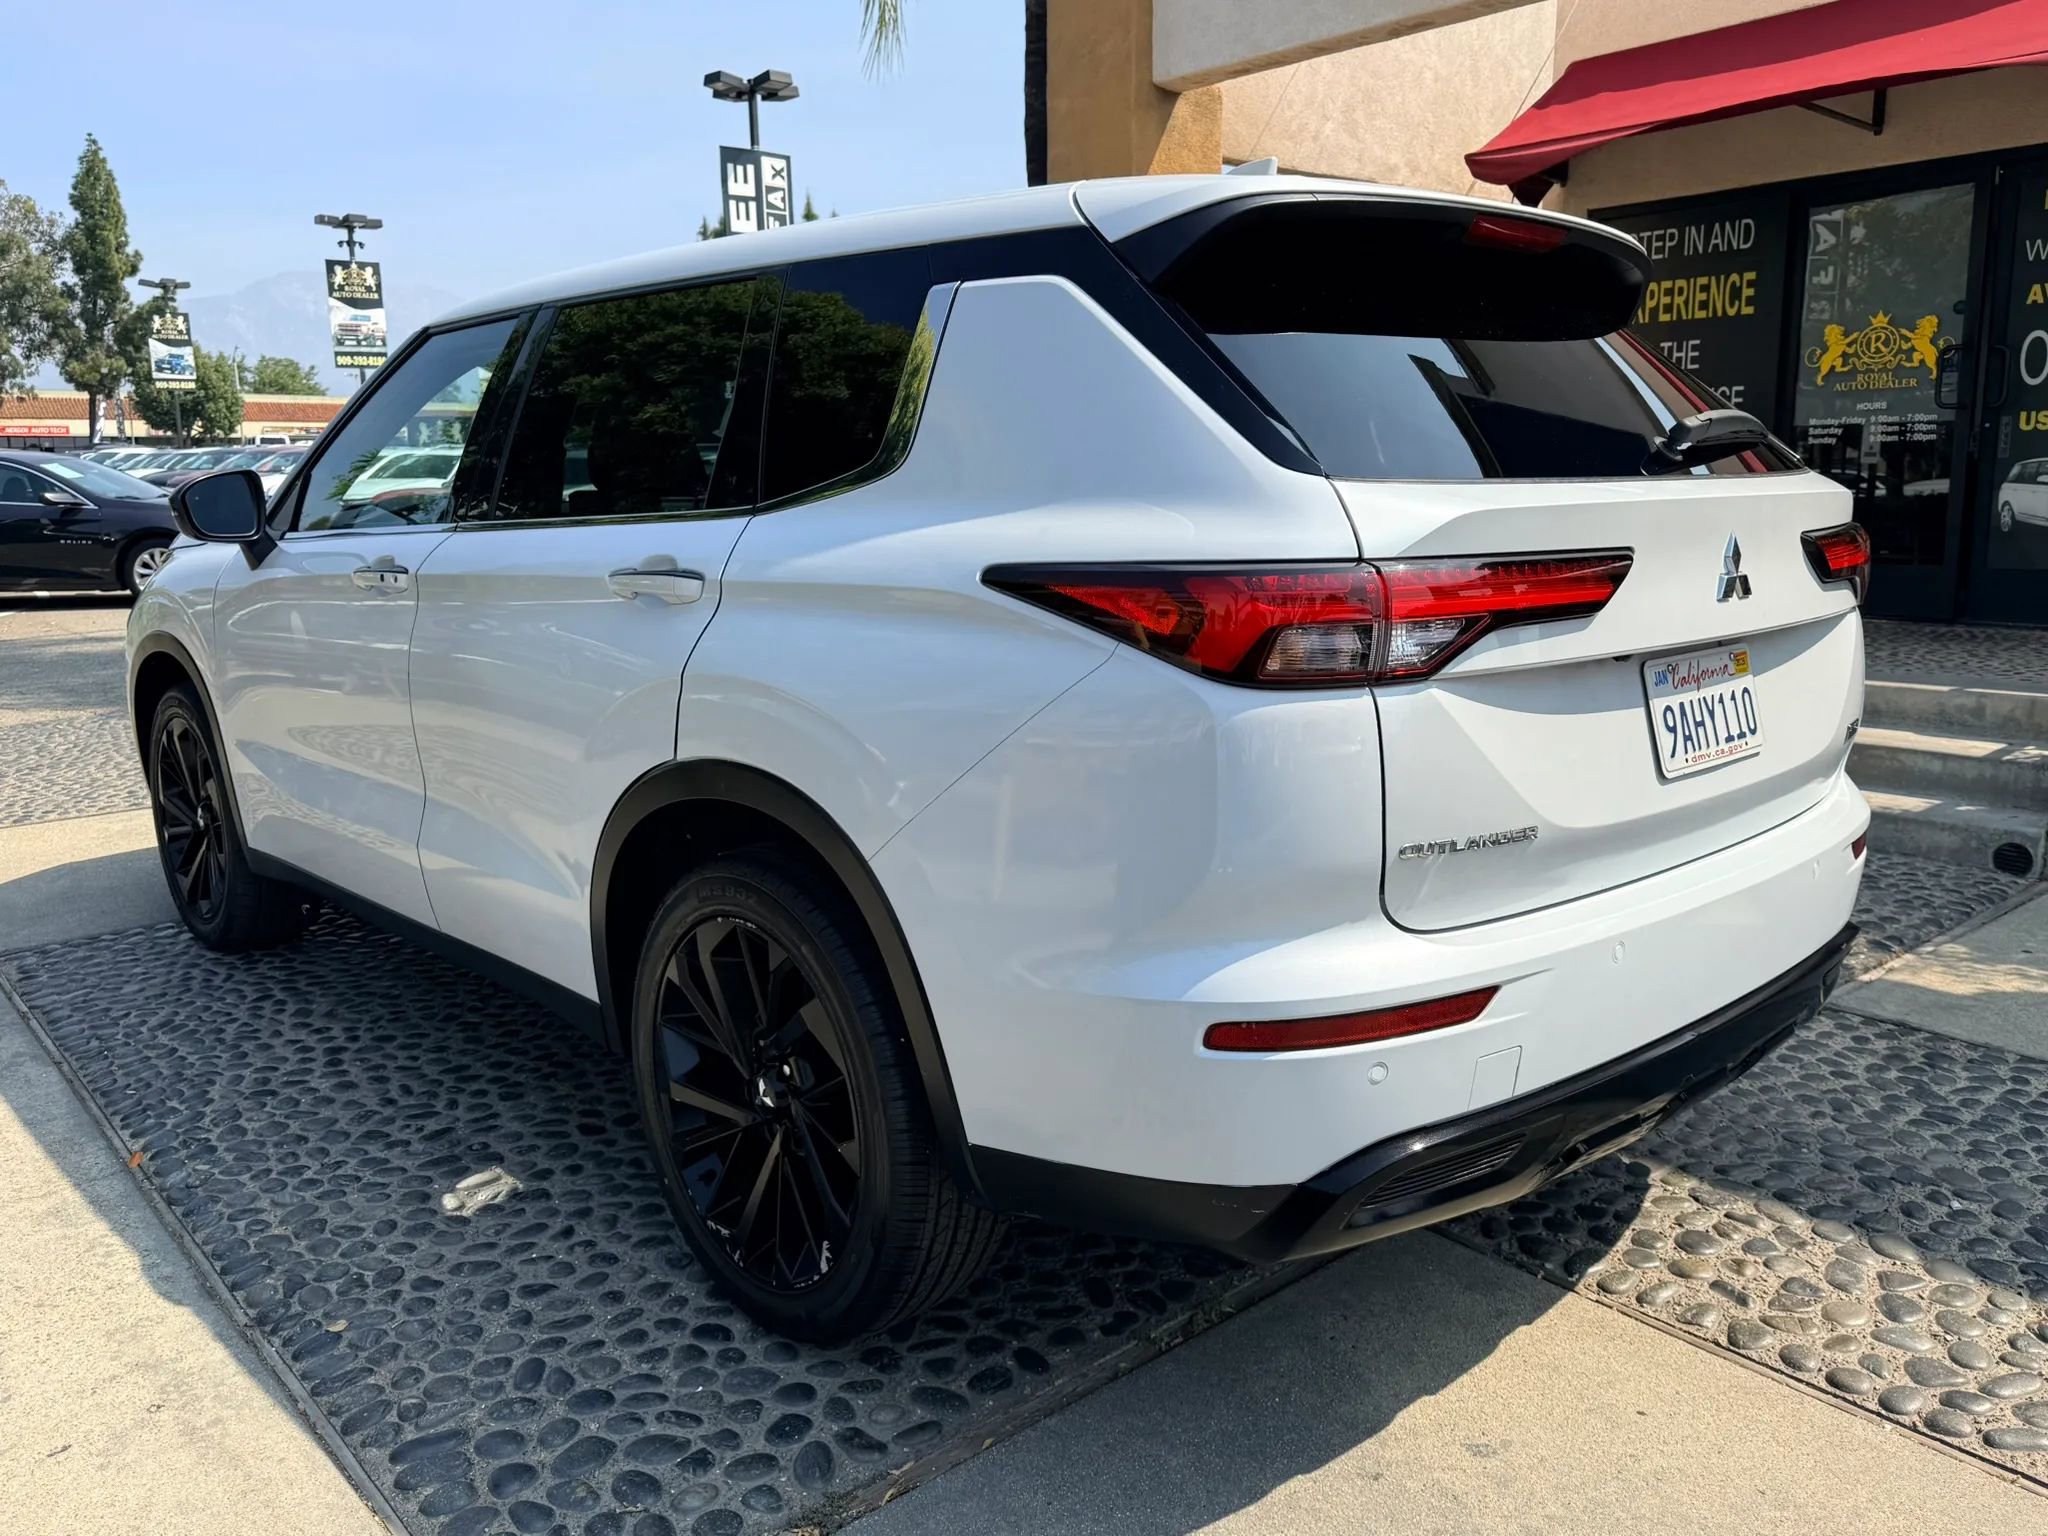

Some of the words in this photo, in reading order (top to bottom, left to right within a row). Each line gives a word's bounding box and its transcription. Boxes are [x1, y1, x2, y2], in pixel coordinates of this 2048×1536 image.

[1684, 224, 1704, 256] IN
[1708, 218, 1755, 253] AND
[1632, 272, 1757, 325] PERIENCE
[1660, 340, 1700, 370] THE
[1834, 381, 1866, 391] AUTO
[1870, 378, 1918, 389] DEALER
[1857, 372, 1894, 384] ROYAL
[1856, 402, 1887, 410] HOURS
[1906, 413, 1937, 422] 7:00pm
[1808, 437, 1837, 445] Sunday
[1906, 433, 1937, 442] 7:00pm
[1809, 427, 1844, 435] Saturday
[1906, 423, 1937, 432] 7:00pm
[1654, 669, 1669, 687] JAN
[1668, 660, 1735, 692] California
[1663, 686, 1757, 759] 9AHY110
[1691, 742, 1743, 763] dmv.ca.gov
[1399, 825, 1539, 860] OUTLANDER
